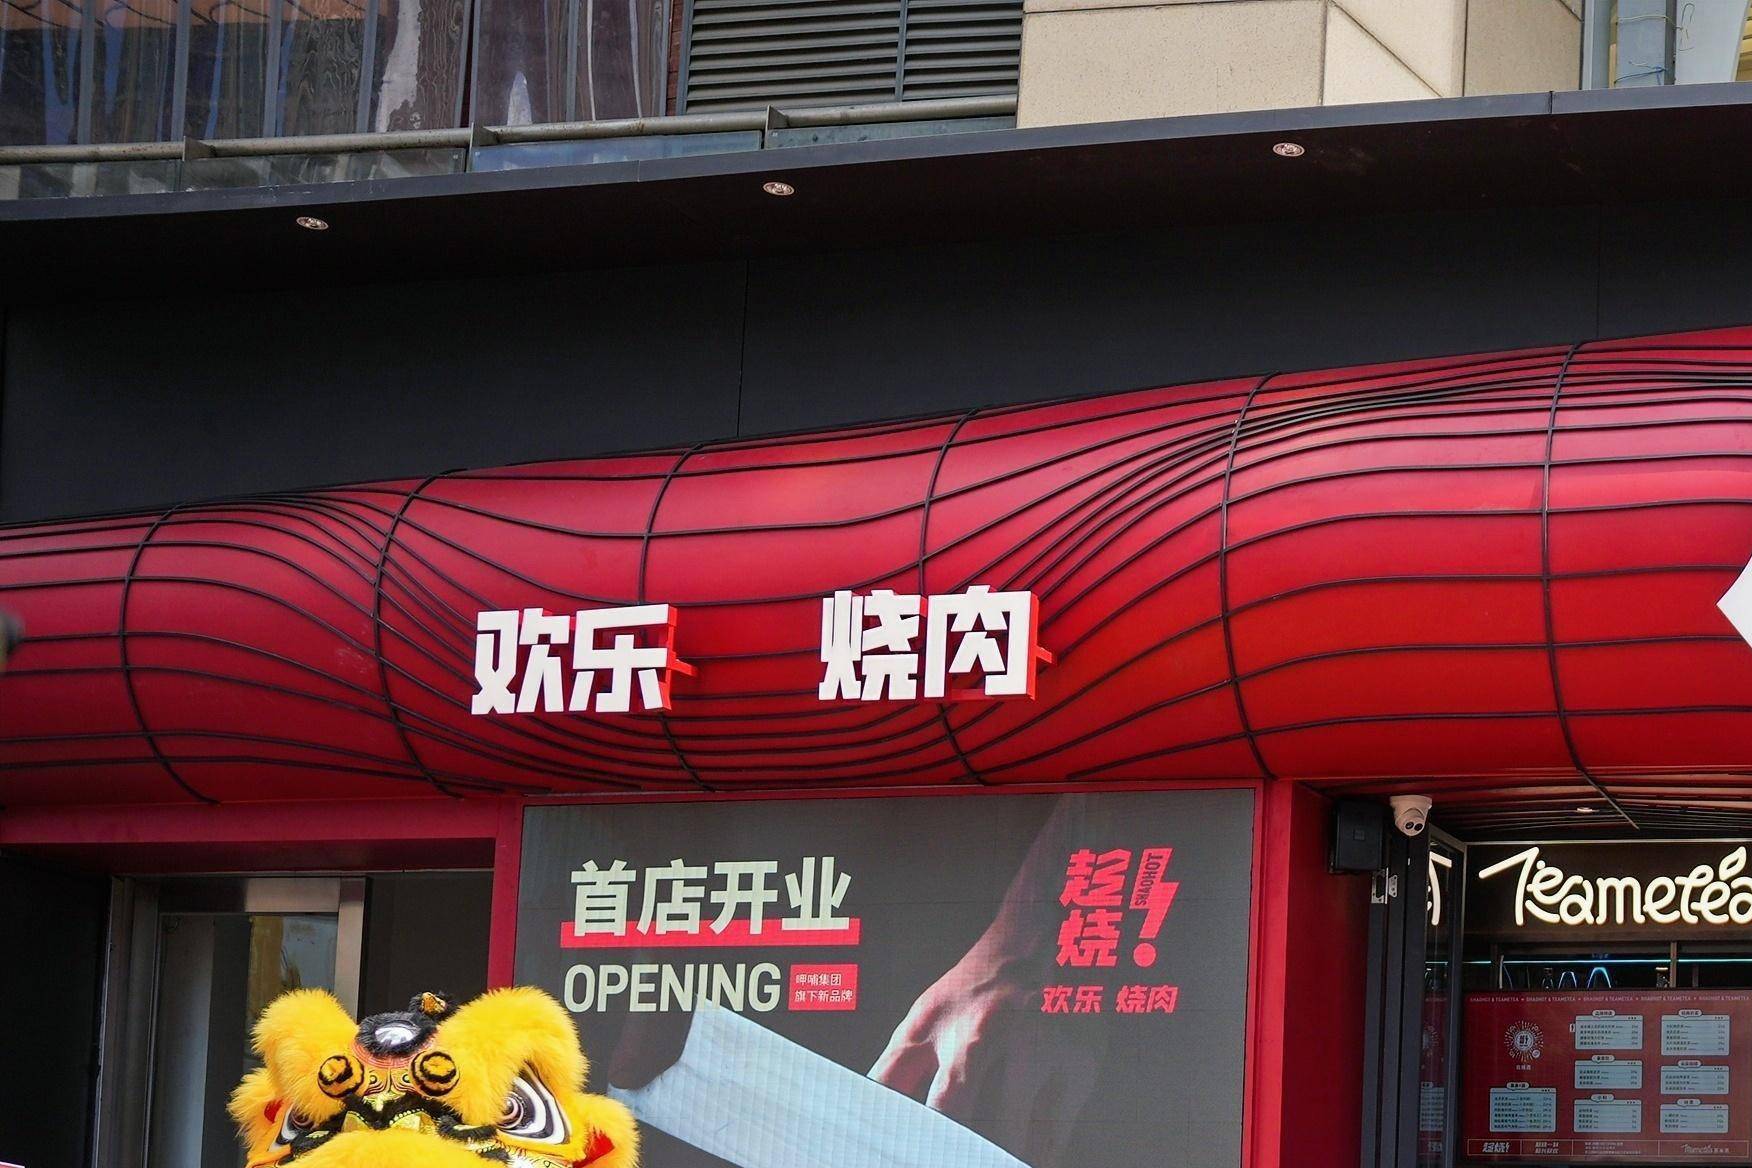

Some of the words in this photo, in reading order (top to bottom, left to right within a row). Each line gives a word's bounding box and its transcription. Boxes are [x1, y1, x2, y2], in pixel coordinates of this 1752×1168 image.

[470, 604, 676, 716] 欢乐
[818, 585, 1036, 702] 烧肉
[570, 856, 851, 937] 首店开业
[1135, 853, 1164, 906] SHAOHOT
[564, 961, 781, 1014] OPENING
[794, 990, 853, 1002] 旗下新品牌
[795, 973, 842, 986] 呷哺集团
[1041, 984, 1104, 1014] 欢乐
[1116, 984, 1179, 1014] 烧肉
